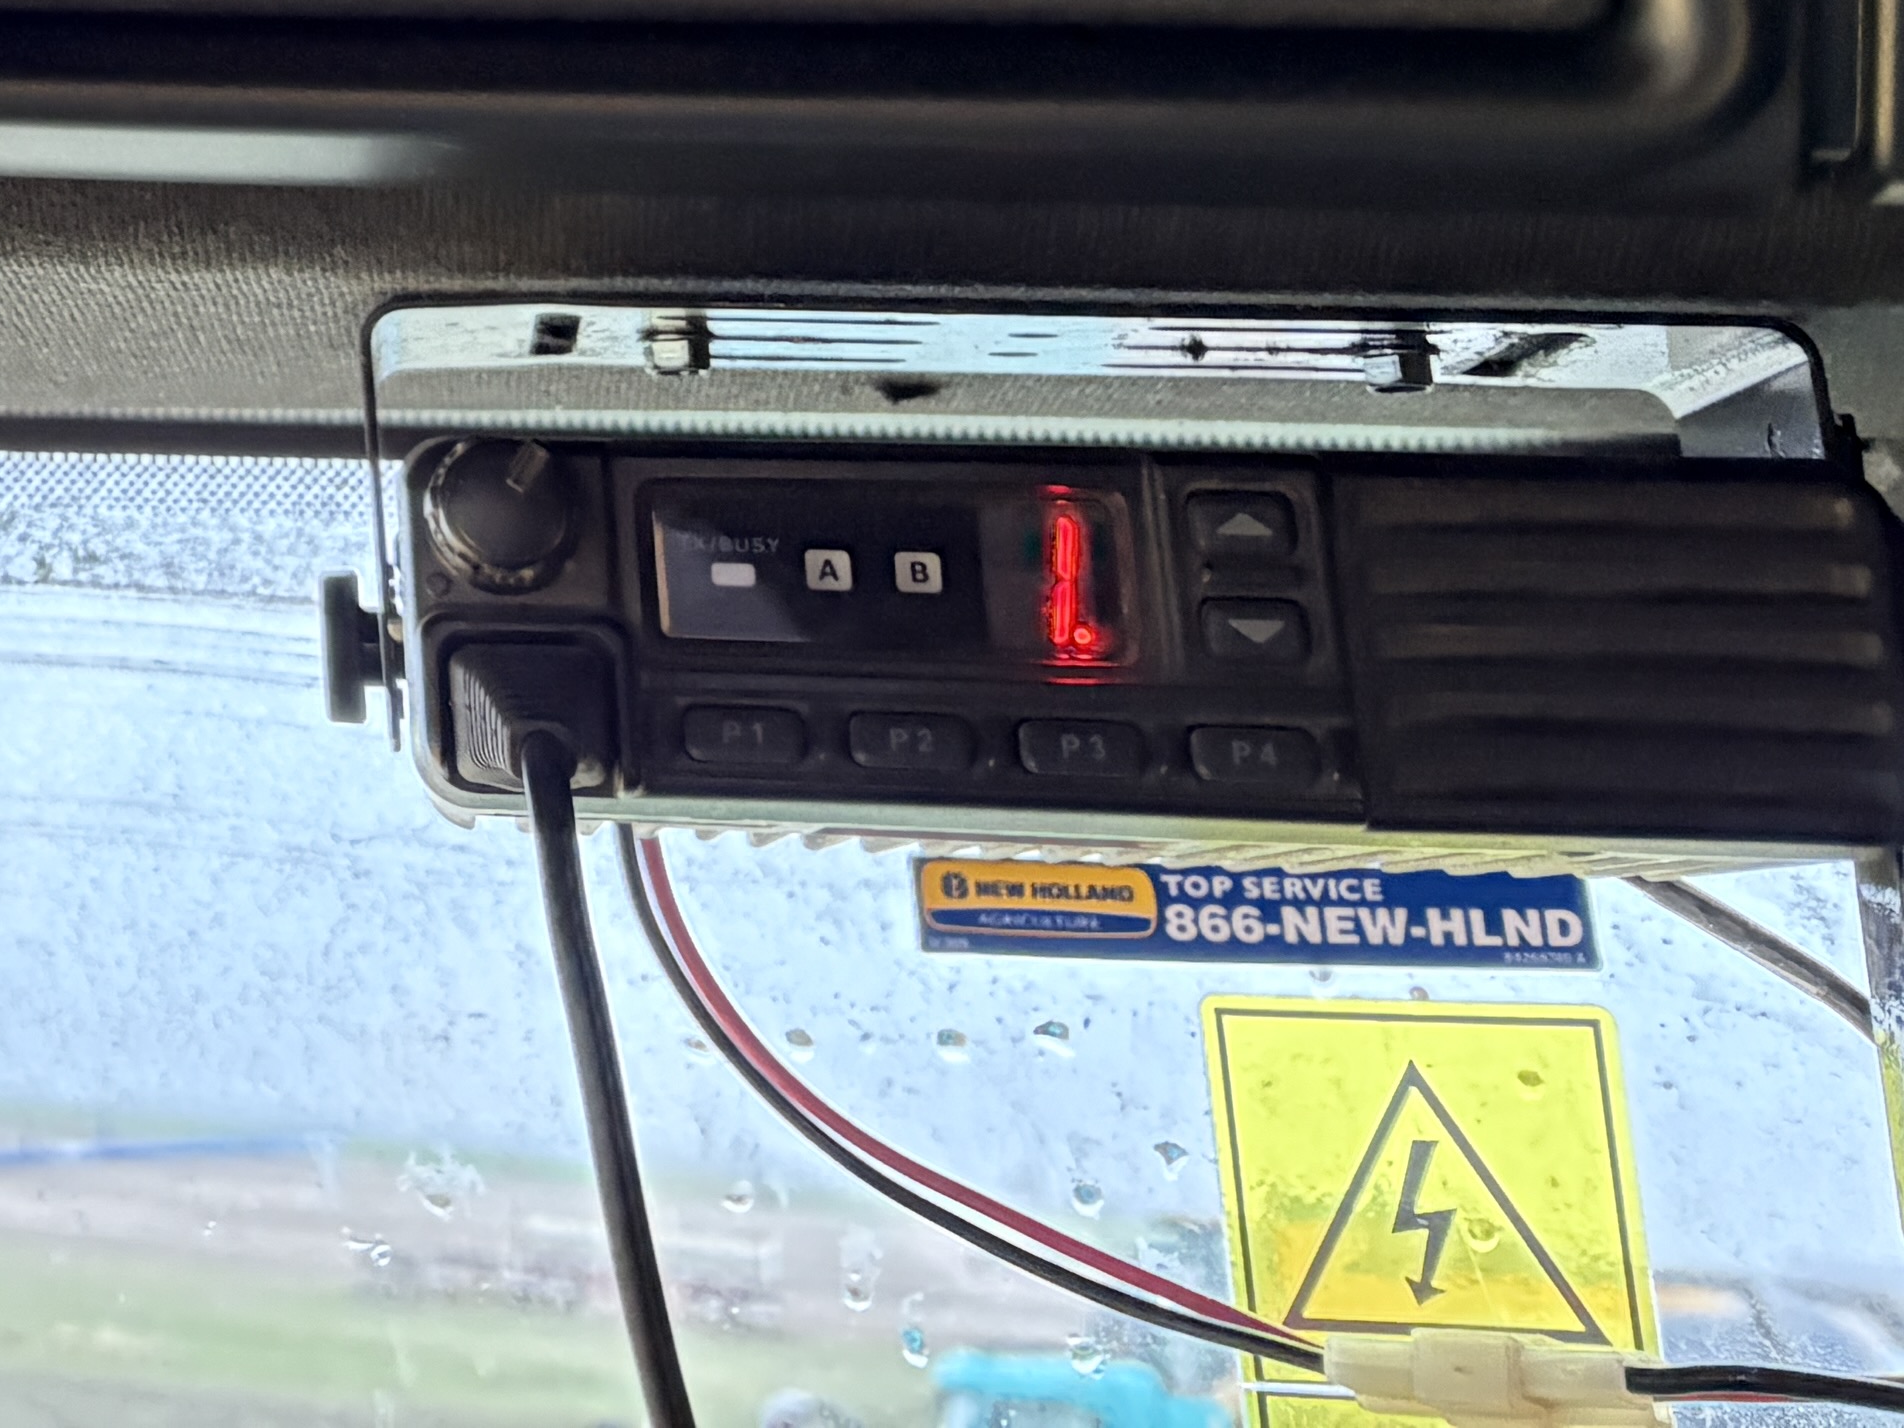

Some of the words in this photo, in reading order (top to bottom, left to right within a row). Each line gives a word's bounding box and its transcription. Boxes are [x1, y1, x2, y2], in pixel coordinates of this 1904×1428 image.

[818, 558, 840, 582] A
[910, 560, 930, 584] B
[1031, 882, 1134, 902] HOLLAND
[1160, 874, 1233, 899] TOP
[1244, 876, 1383, 902] SERVICE
[1164, 904, 1583, 947] 866-NEW-HLND
